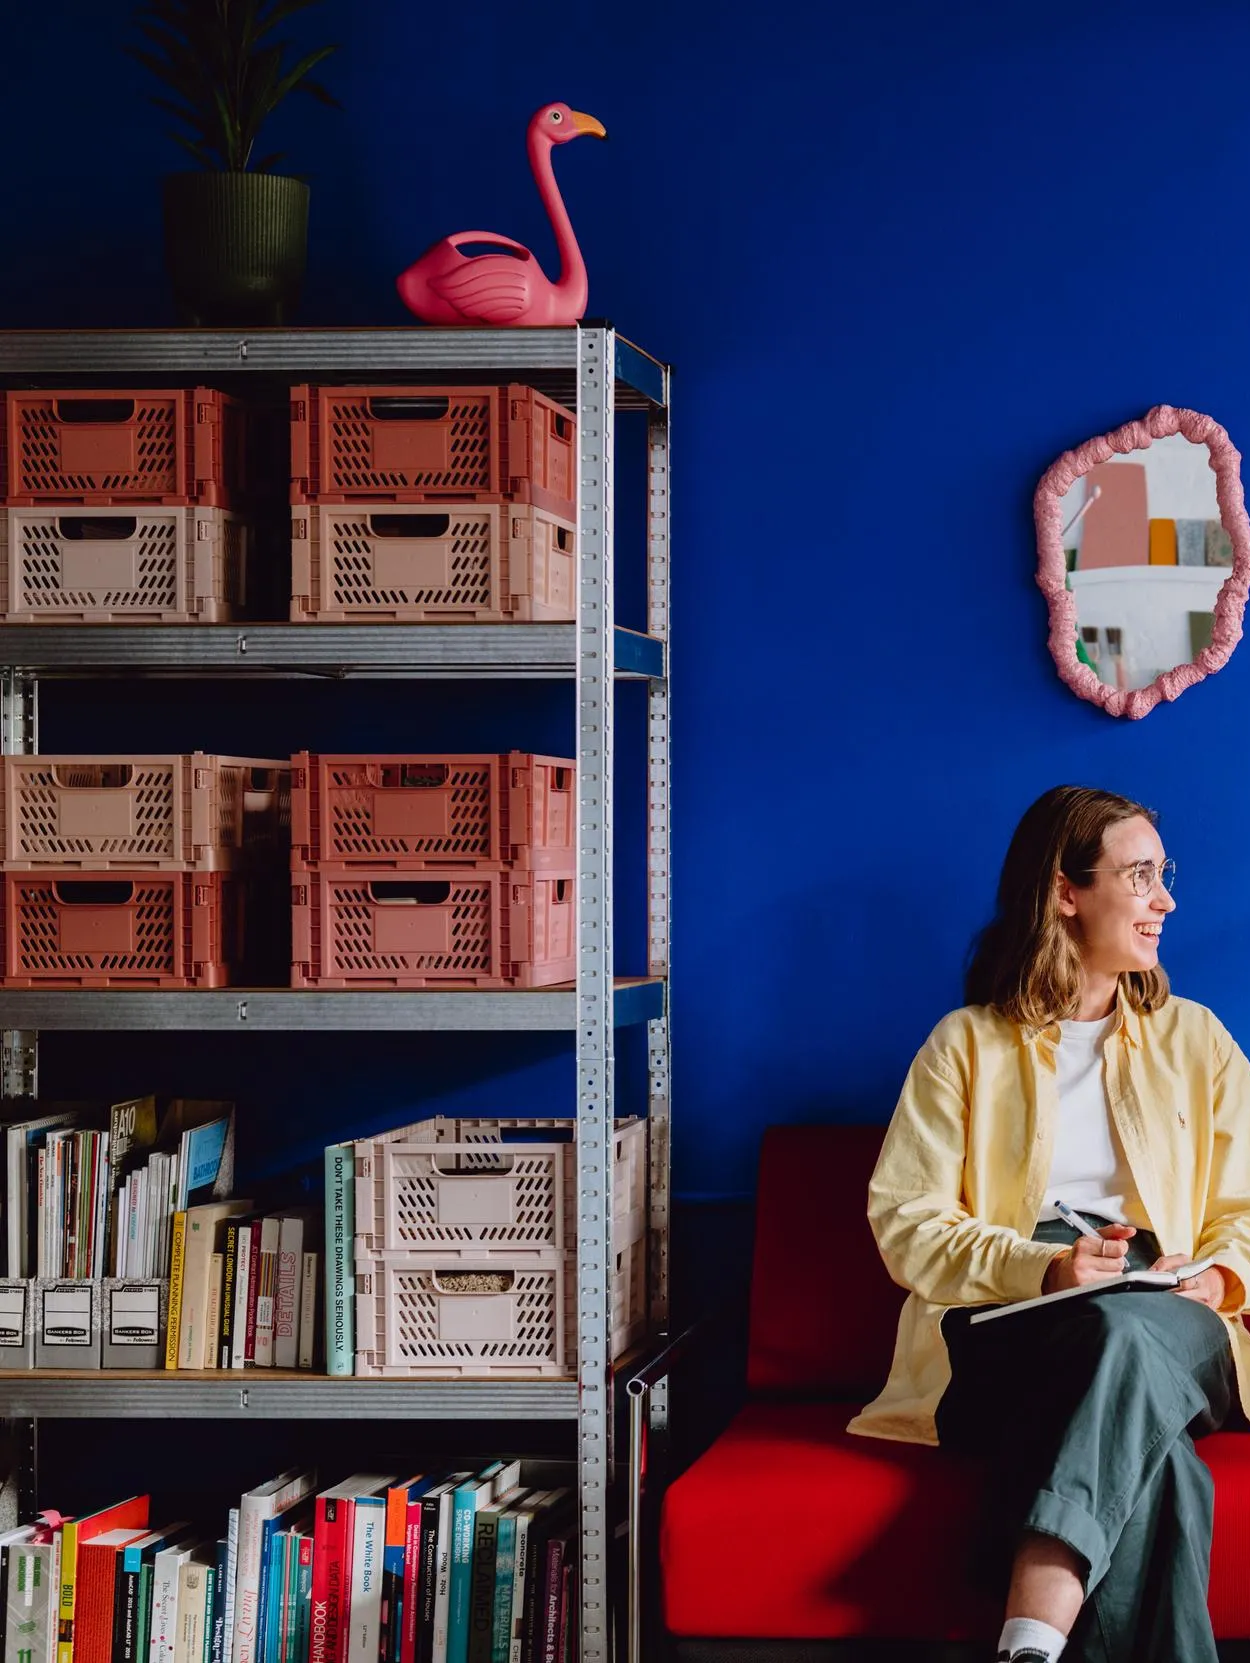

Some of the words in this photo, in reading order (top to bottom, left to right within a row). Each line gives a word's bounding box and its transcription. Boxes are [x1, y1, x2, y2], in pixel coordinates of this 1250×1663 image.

[118, 1106, 136, 1139] A10
[335, 1157, 343, 1183] DON'T
[173, 1231, 182, 1272] COMPLETE
[227, 1227, 235, 1253] SECRET
[225, 1254, 234, 1282] LONDON
[171, 1274, 180, 1315] PLANNING
[225, 1283, 231, 1291] AN
[277, 1252, 297, 1337] DETAILS
[169, 1317, 178, 1362] PERMISSION
[336, 1299, 344, 1353] SERIOUSLY.
[366, 1522, 375, 1538] The
[455, 1509, 463, 1532] SPACE
[454, 1533, 462, 1563] DESIGNS
[462, 1509, 471, 1563] CO-WORKING
[365, 1540, 374, 1568] White
[410, 1545, 418, 1581] Contemporary
[426, 1544, 434, 1587] Construction
[551, 1548, 560, 1582] Materials
[163, 1580, 171, 1592] The
[329, 1561, 340, 1587] DATA
[363, 1570, 373, 1592] Book
[476, 1523, 495, 1632] RECLAIMED
[63, 1585, 74, 1607] BOLD
[161, 1594, 170, 1615] Secret
[328, 1588, 339, 1627] DESIGN
[426, 1588, 432, 1597] of
[160, 1616, 168, 1634] Lives
[238, 1589, 258, 1641] Living
[499, 1585, 511, 1649] MATERIALS
[547, 1595, 557, 1642] Architects
[313, 1600, 327, 1663] HANDBOOK
[326, 1628, 338, 1650] AND
[547, 1644, 555, 1653] &
